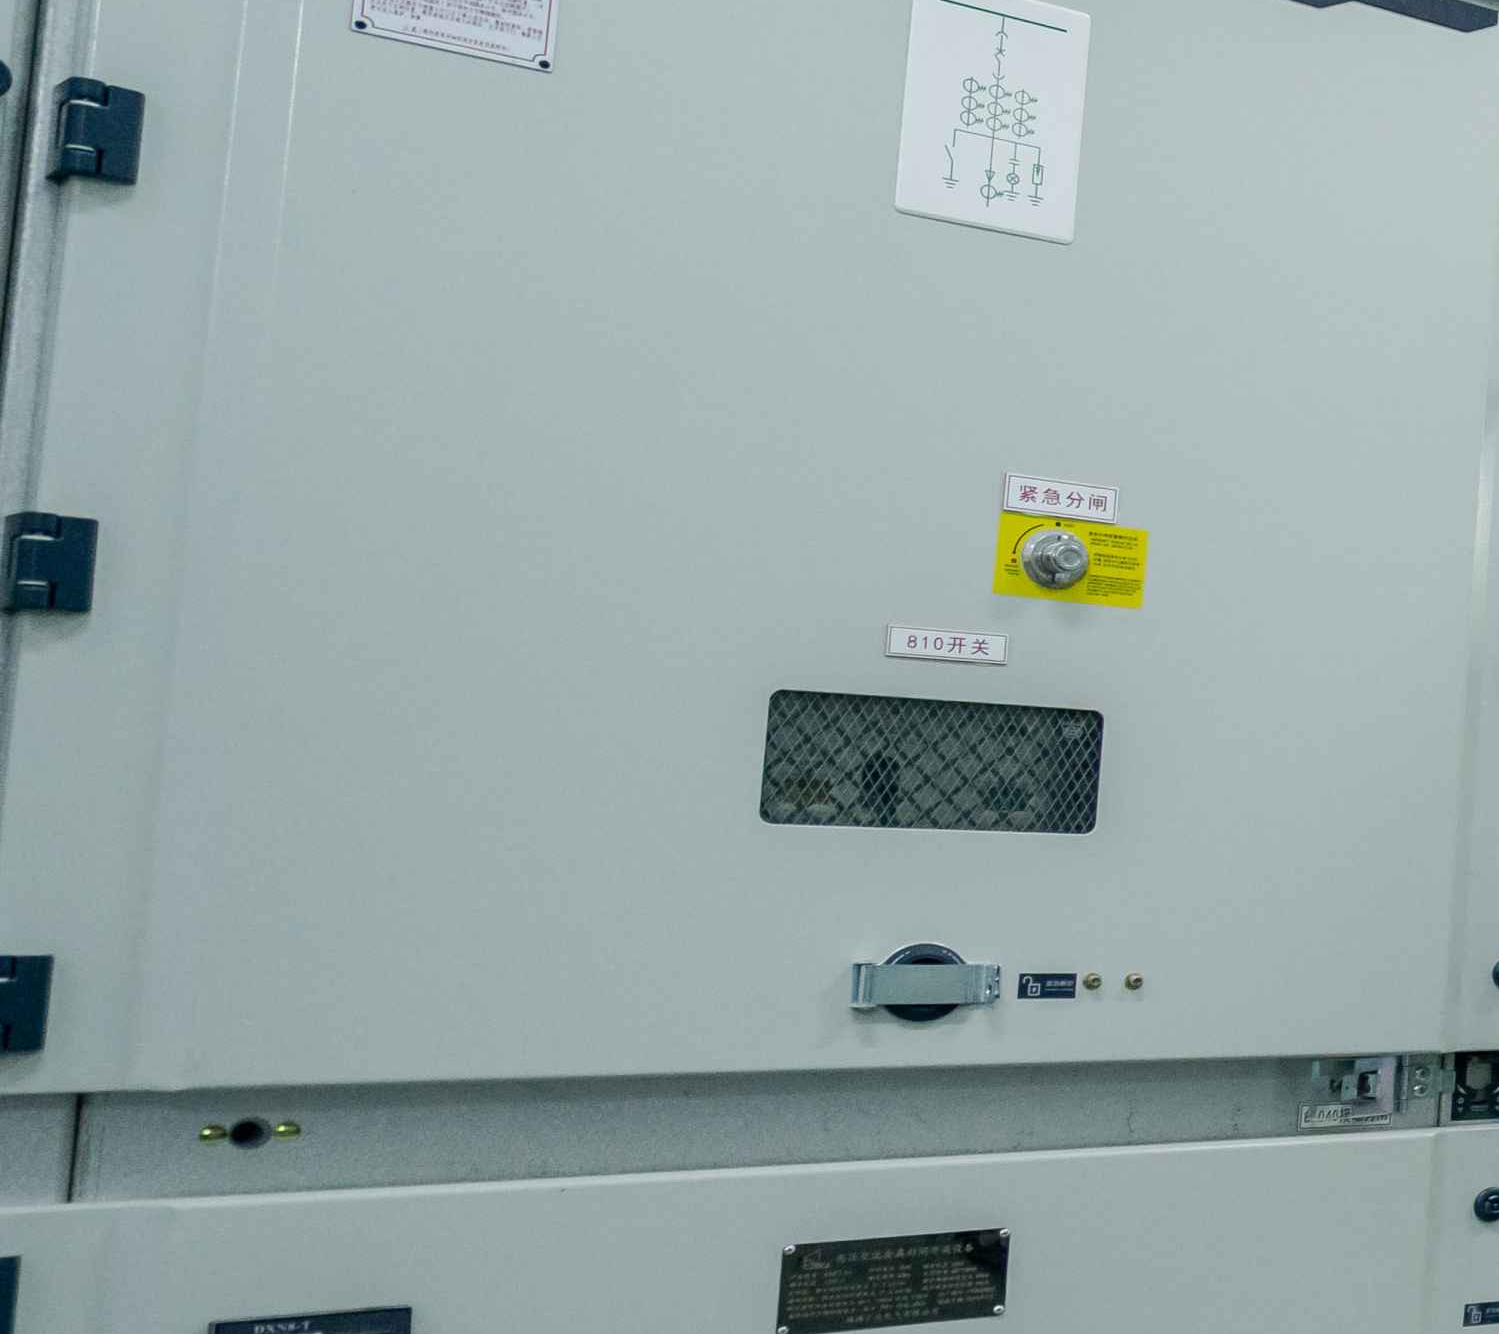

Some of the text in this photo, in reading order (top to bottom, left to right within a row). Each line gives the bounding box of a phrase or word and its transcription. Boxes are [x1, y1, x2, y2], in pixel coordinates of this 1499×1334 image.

[1019, 484, 1108, 513] 紧急分闸
[906, 634, 991, 656] 810开关
